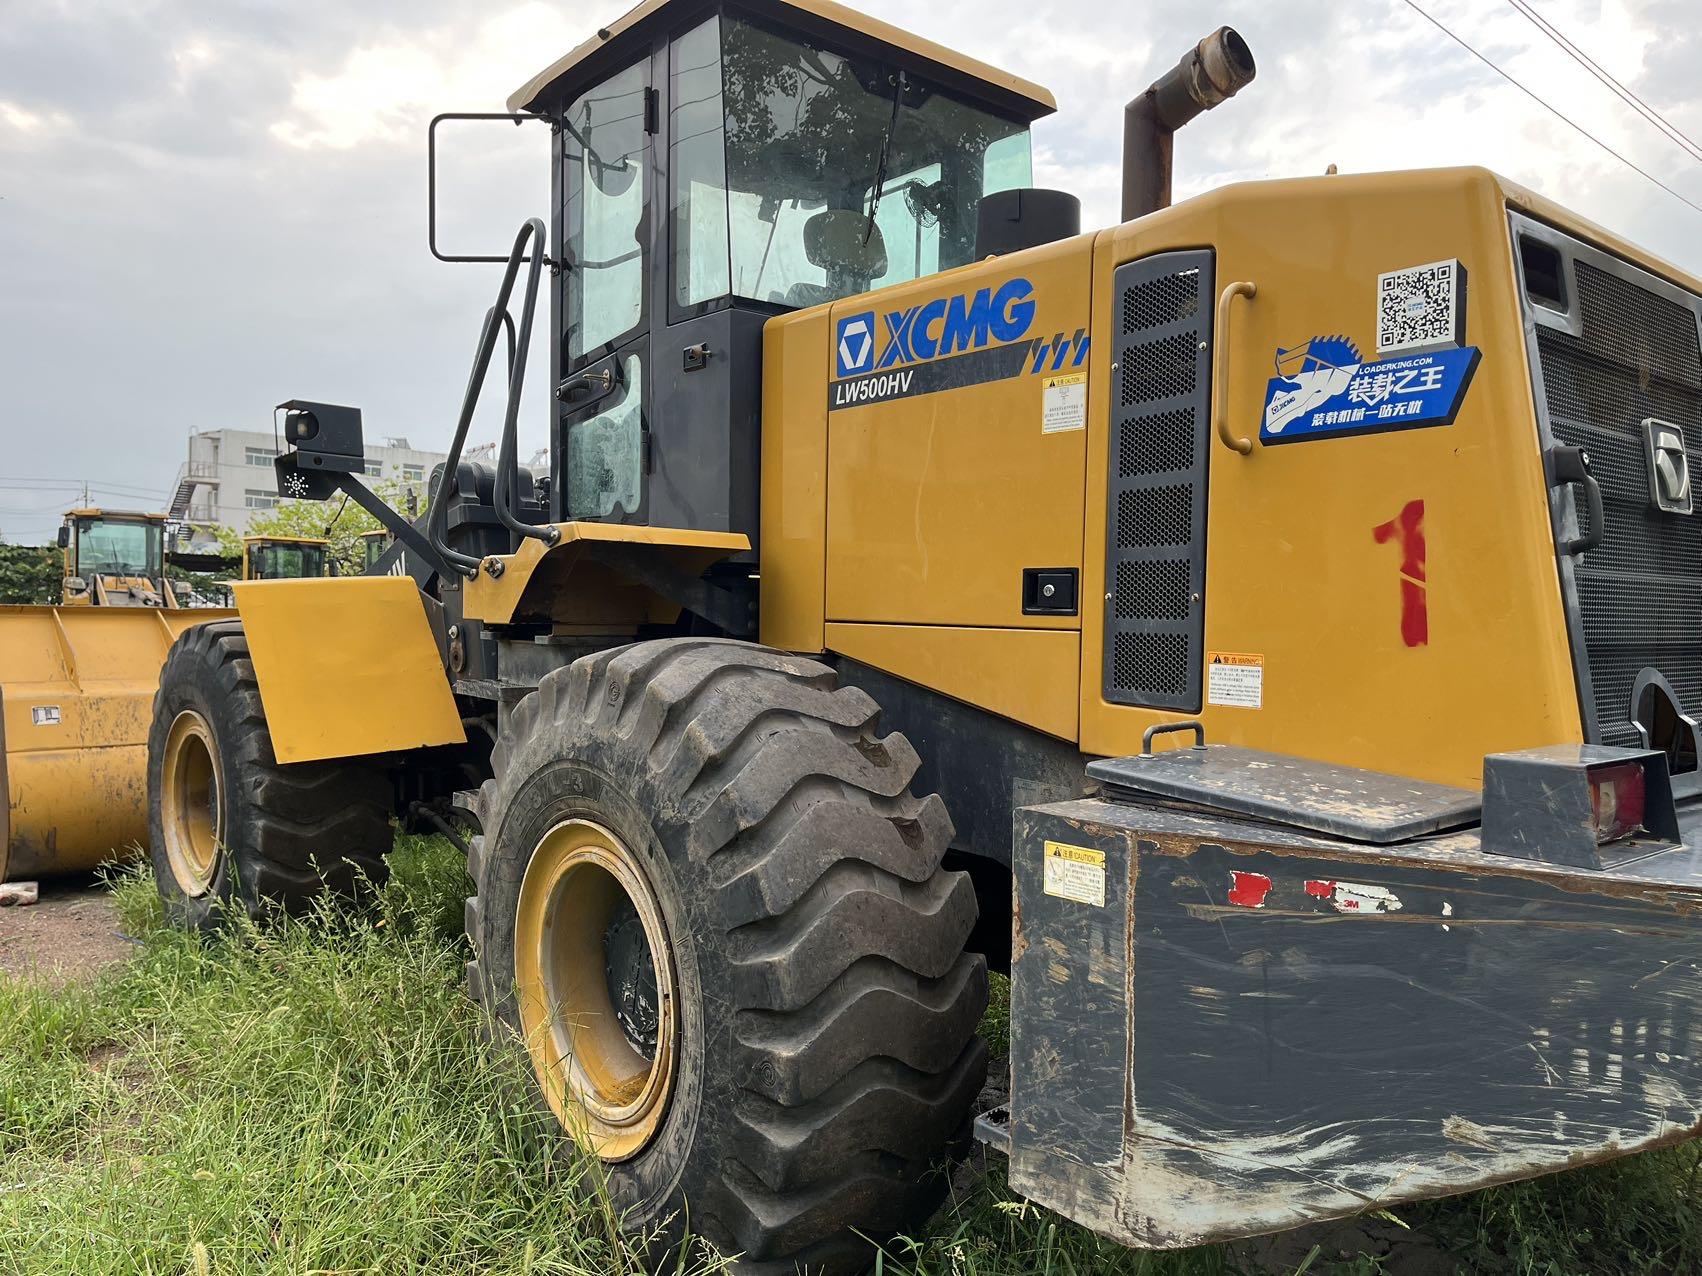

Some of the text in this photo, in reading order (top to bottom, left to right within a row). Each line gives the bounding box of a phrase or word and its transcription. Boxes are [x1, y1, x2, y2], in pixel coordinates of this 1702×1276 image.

[874, 278, 1036, 369] XCMG
[1359, 357, 1433, 375] LOADERKING.COM
[836, 370, 914, 405] LW500HV
[1348, 366, 1445, 407] 装载之王
[1311, 400, 1423, 427] 装载机械一站无忧
[1372, 498, 1428, 647] 1
[1343, 899, 1360, 910] 3M
